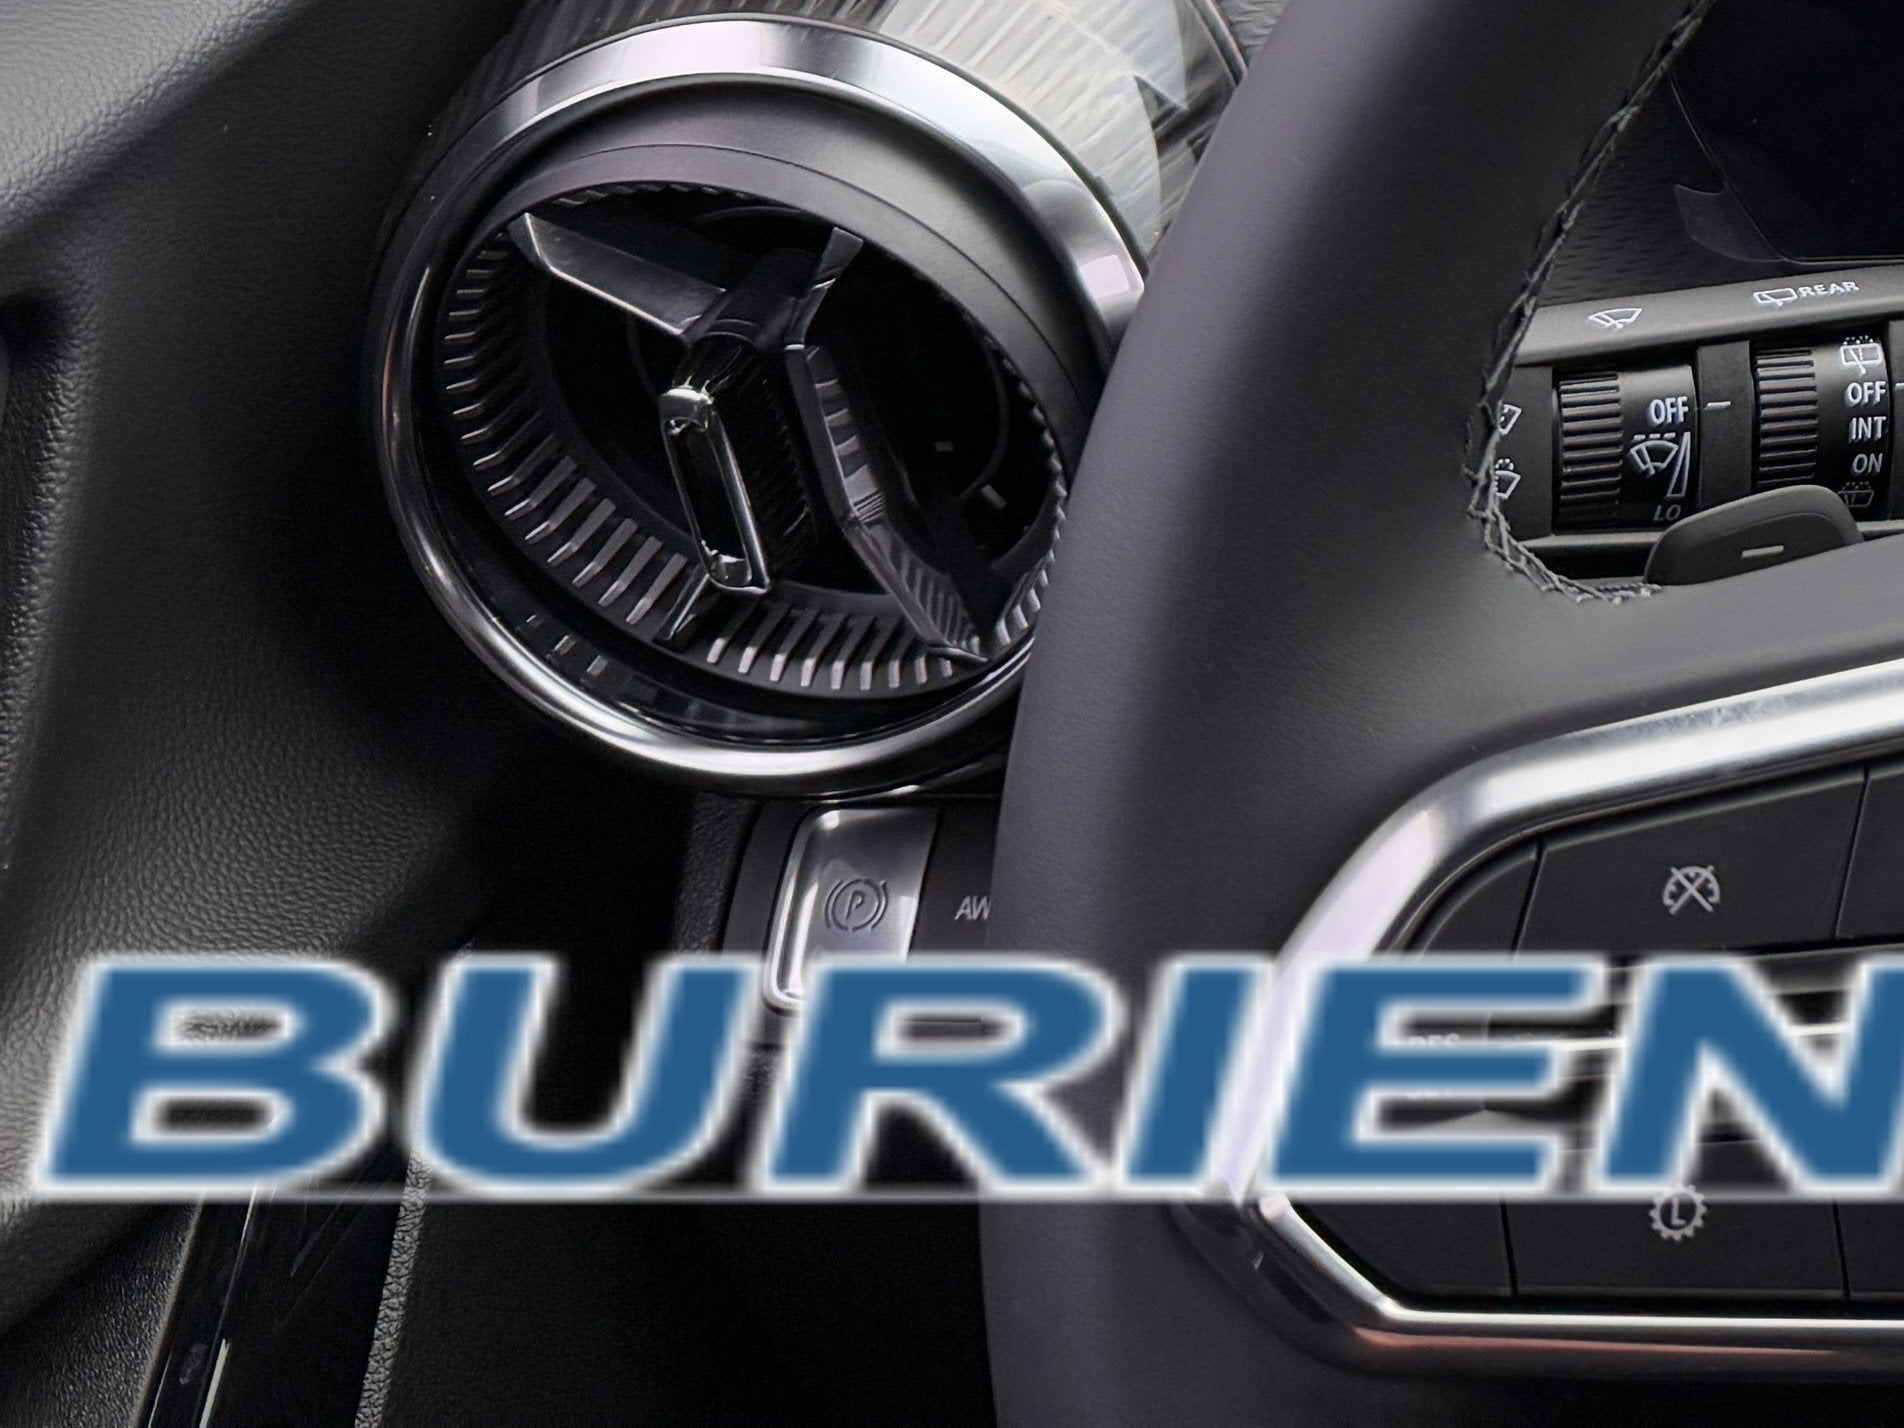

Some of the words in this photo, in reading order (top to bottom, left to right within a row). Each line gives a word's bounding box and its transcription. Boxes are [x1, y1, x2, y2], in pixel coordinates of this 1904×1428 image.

[1798, 280, 1860, 299] REAR
[1847, 380, 1887, 407] OFF
[1649, 395, 1689, 425] OFF
[1850, 415, 1887, 443] INT
[1853, 452, 1884, 474] ON
[1652, 503, 1682, 522] LO
